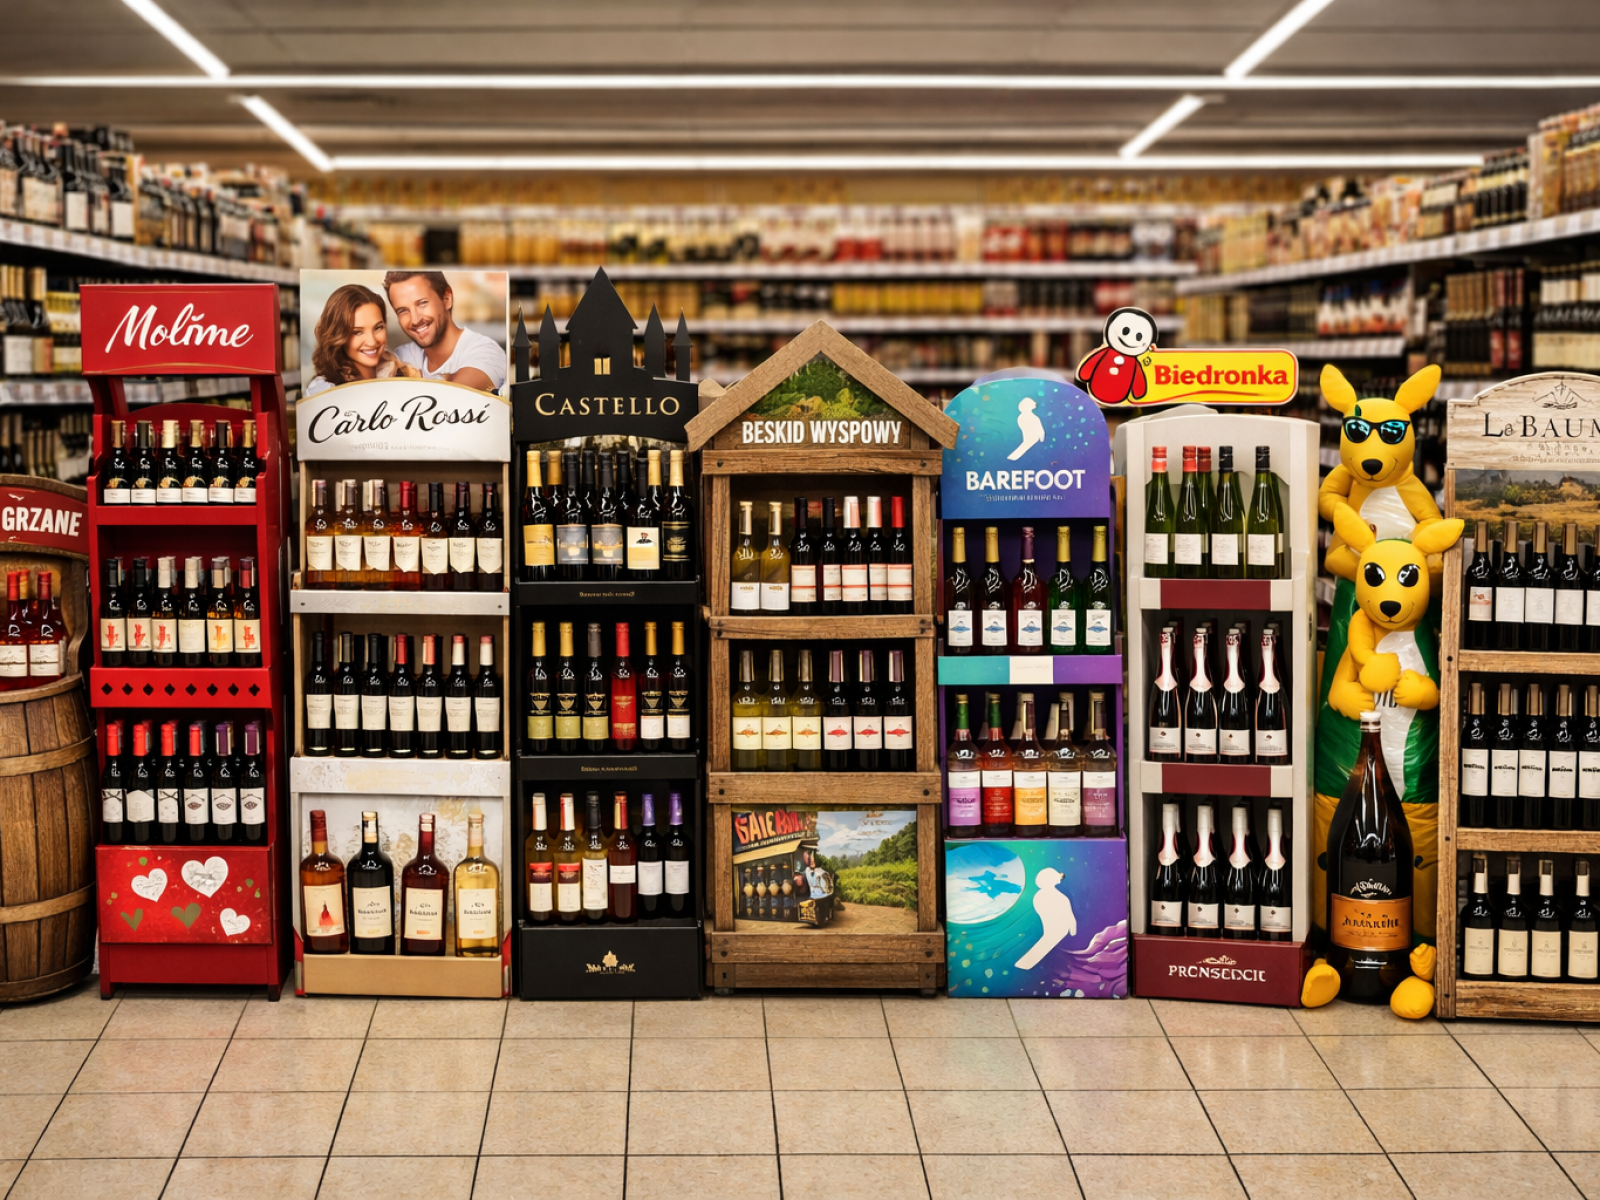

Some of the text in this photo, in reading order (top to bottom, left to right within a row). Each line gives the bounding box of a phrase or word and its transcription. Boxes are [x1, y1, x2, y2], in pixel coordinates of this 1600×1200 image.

[1154, 364, 1289, 386] Biedronka
[308, 395, 490, 444] Carlo Rossi
[742, 420, 902, 444] BESKID WYSPOWY
[966, 469, 1086, 491] BAREFOOT
[2, 506, 83, 537] GRZANE
